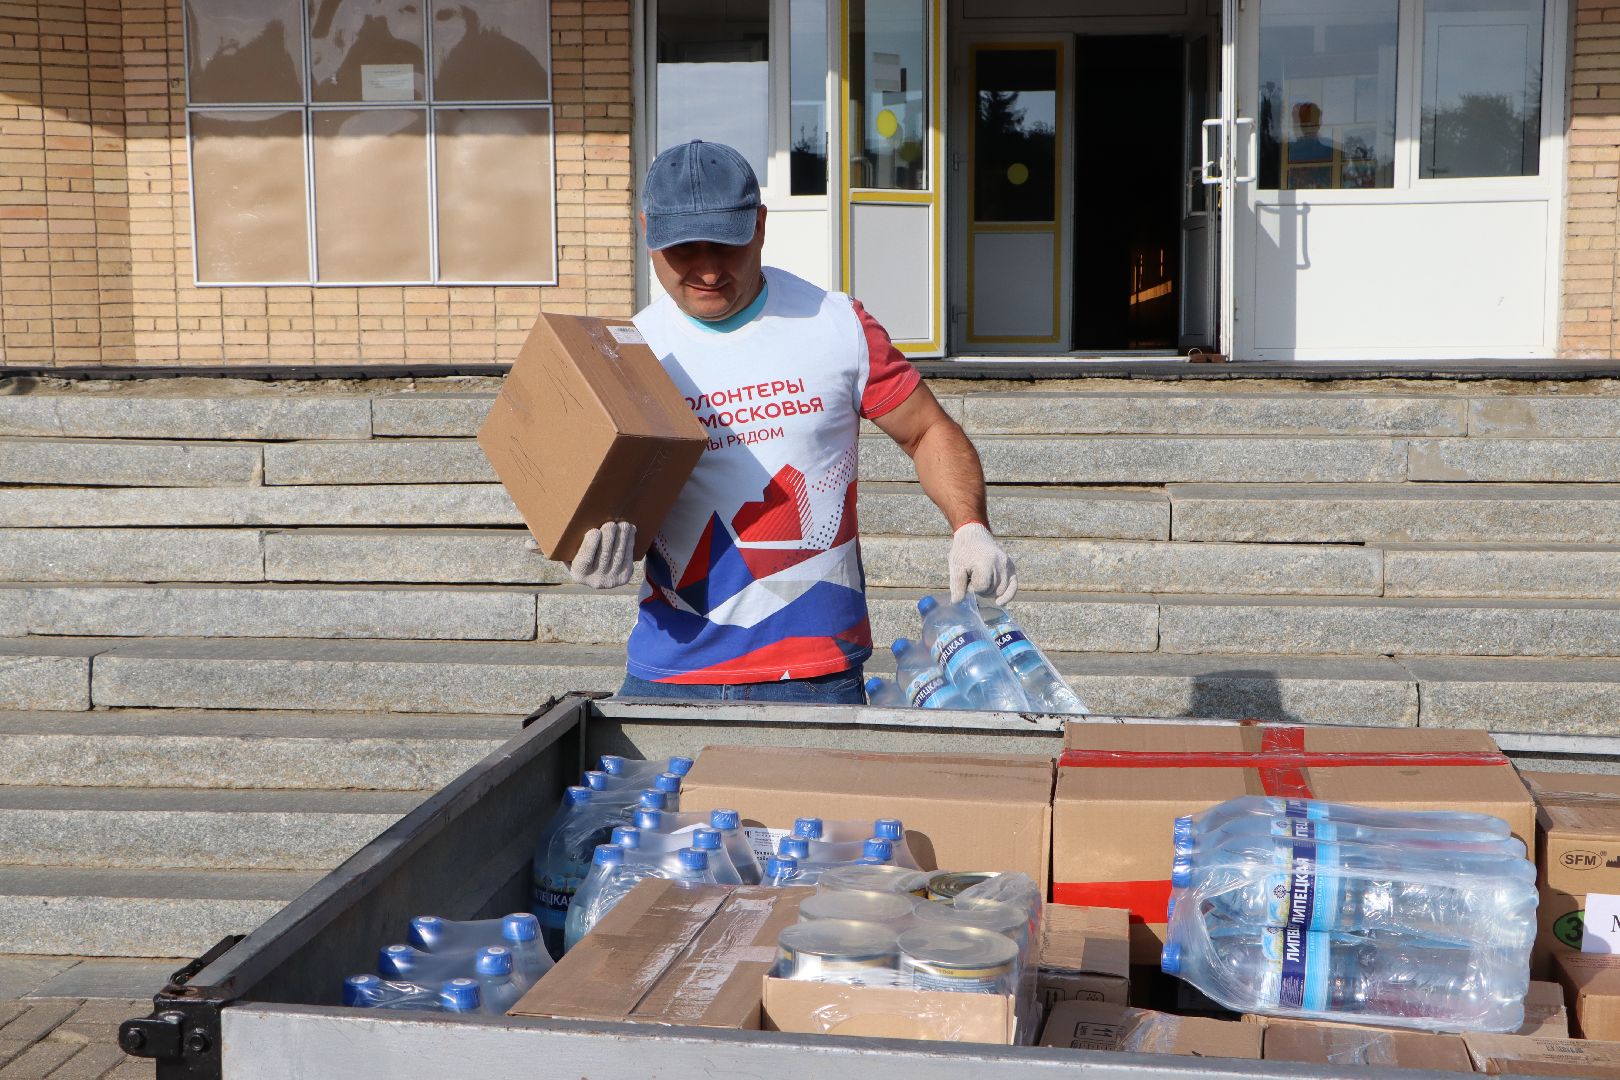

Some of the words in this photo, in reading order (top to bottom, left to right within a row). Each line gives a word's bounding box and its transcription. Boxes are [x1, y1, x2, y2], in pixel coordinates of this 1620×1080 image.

[727, 426, 785, 448] РЯДОМ
[1564, 854, 1597, 866] SFM
[1291, 857, 1311, 924] ЛИПЕЦКАЯ
